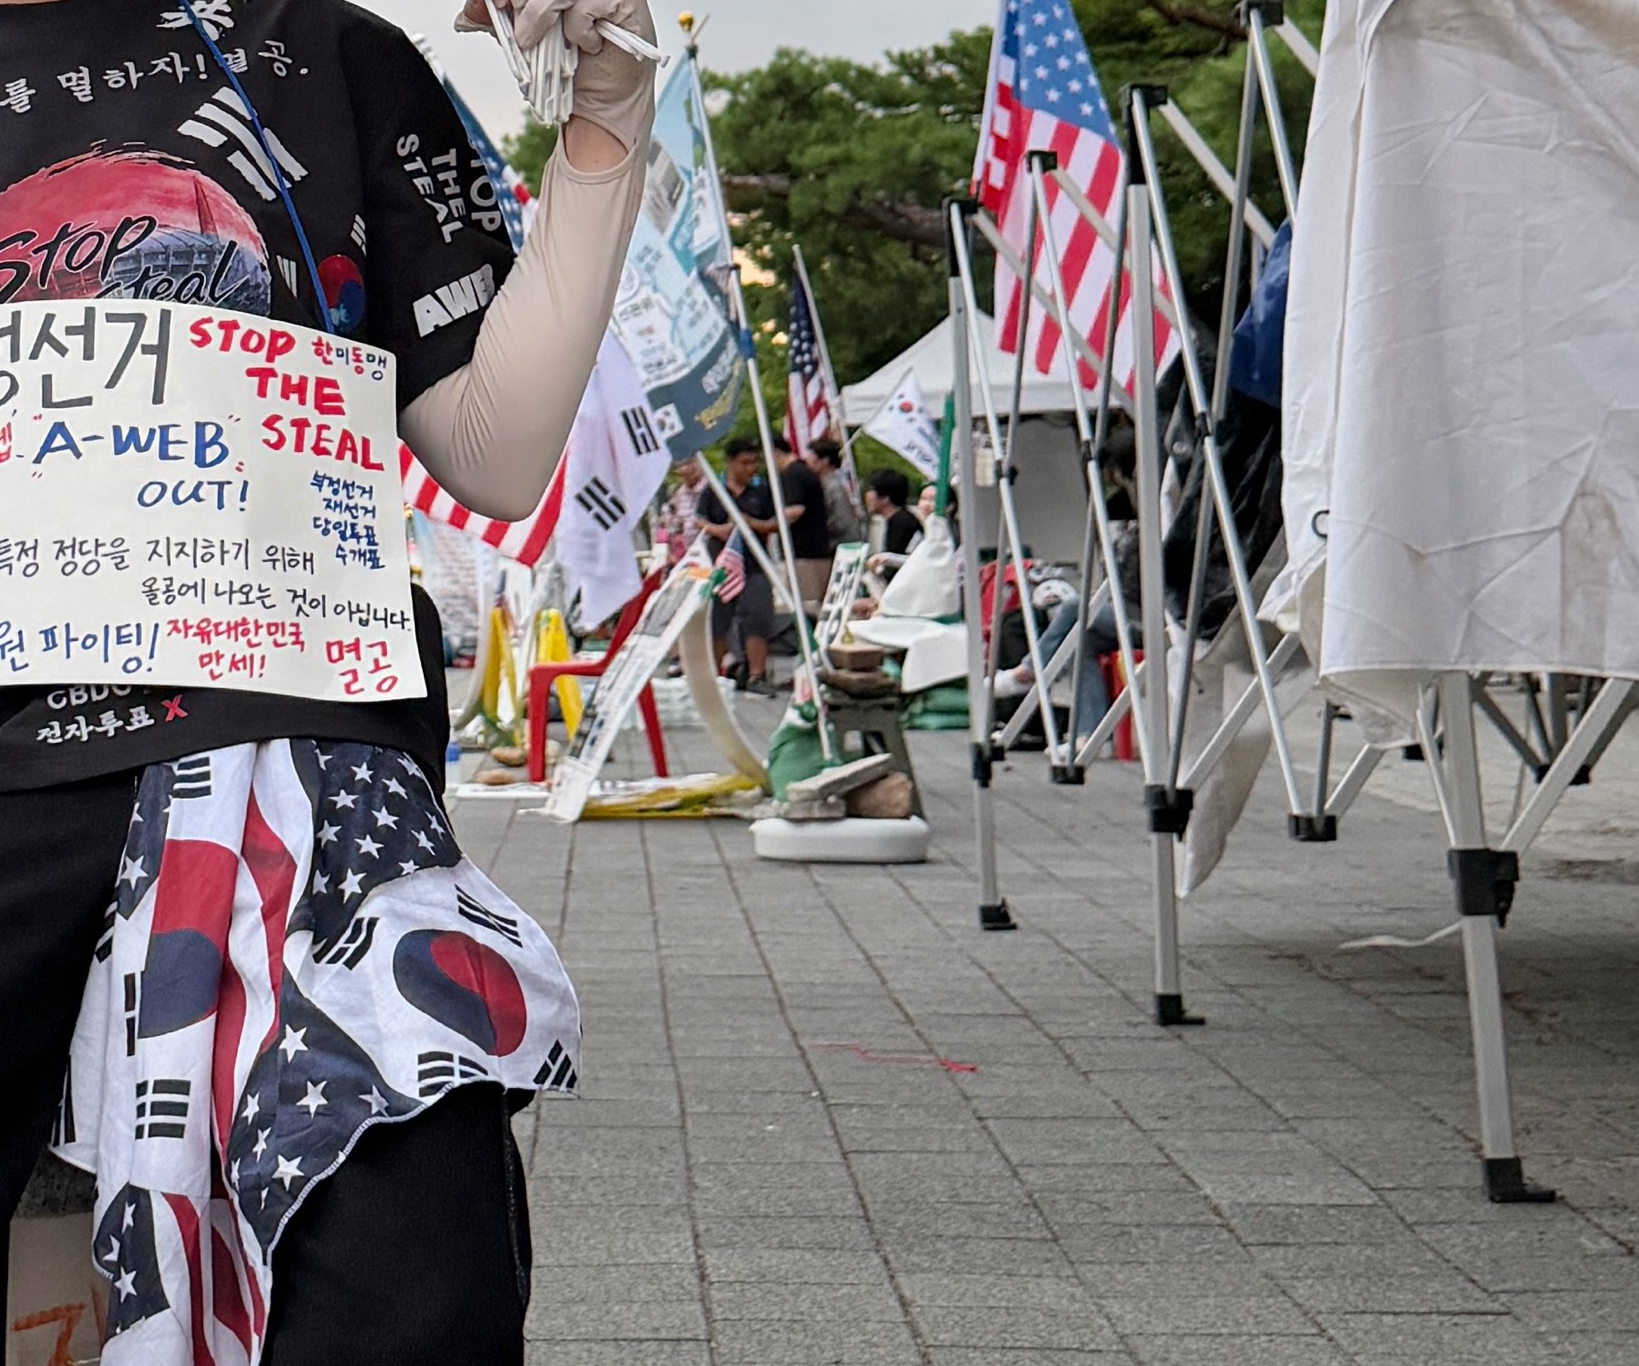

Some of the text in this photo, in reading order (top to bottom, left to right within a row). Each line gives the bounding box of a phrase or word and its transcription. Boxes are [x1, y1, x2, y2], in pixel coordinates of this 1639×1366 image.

[56, 51, 208, 102] 멸하자!
[396, 134, 463, 243] STEAL
[431, 148, 466, 217] THE
[189, 317, 296, 363] STOP
[311, 335, 387, 381] 한미동맹
[245, 367, 346, 416] THE
[262, 414, 385, 471] STEAL
[137, 480, 249, 512] OUT!
[323, 498, 376, 519] 재선거
[313, 516, 379, 546] 당일투표
[53, 536, 130, 576] 정당을
[146, 536, 250, 570] 지지하기
[262, 545, 314, 575] 위해
[335, 545, 386, 569] 수개표
[214, 580, 276, 610] 나오는
[287, 588, 326, 617] 것이
[38, 622, 159, 674] 파이팅!
[166, 617, 305, 651] 자유대한민국
[198, 650, 266, 681] 만세!
[325, 637, 399, 695] 멸공
[36, 706, 155, 743] 전자투표
